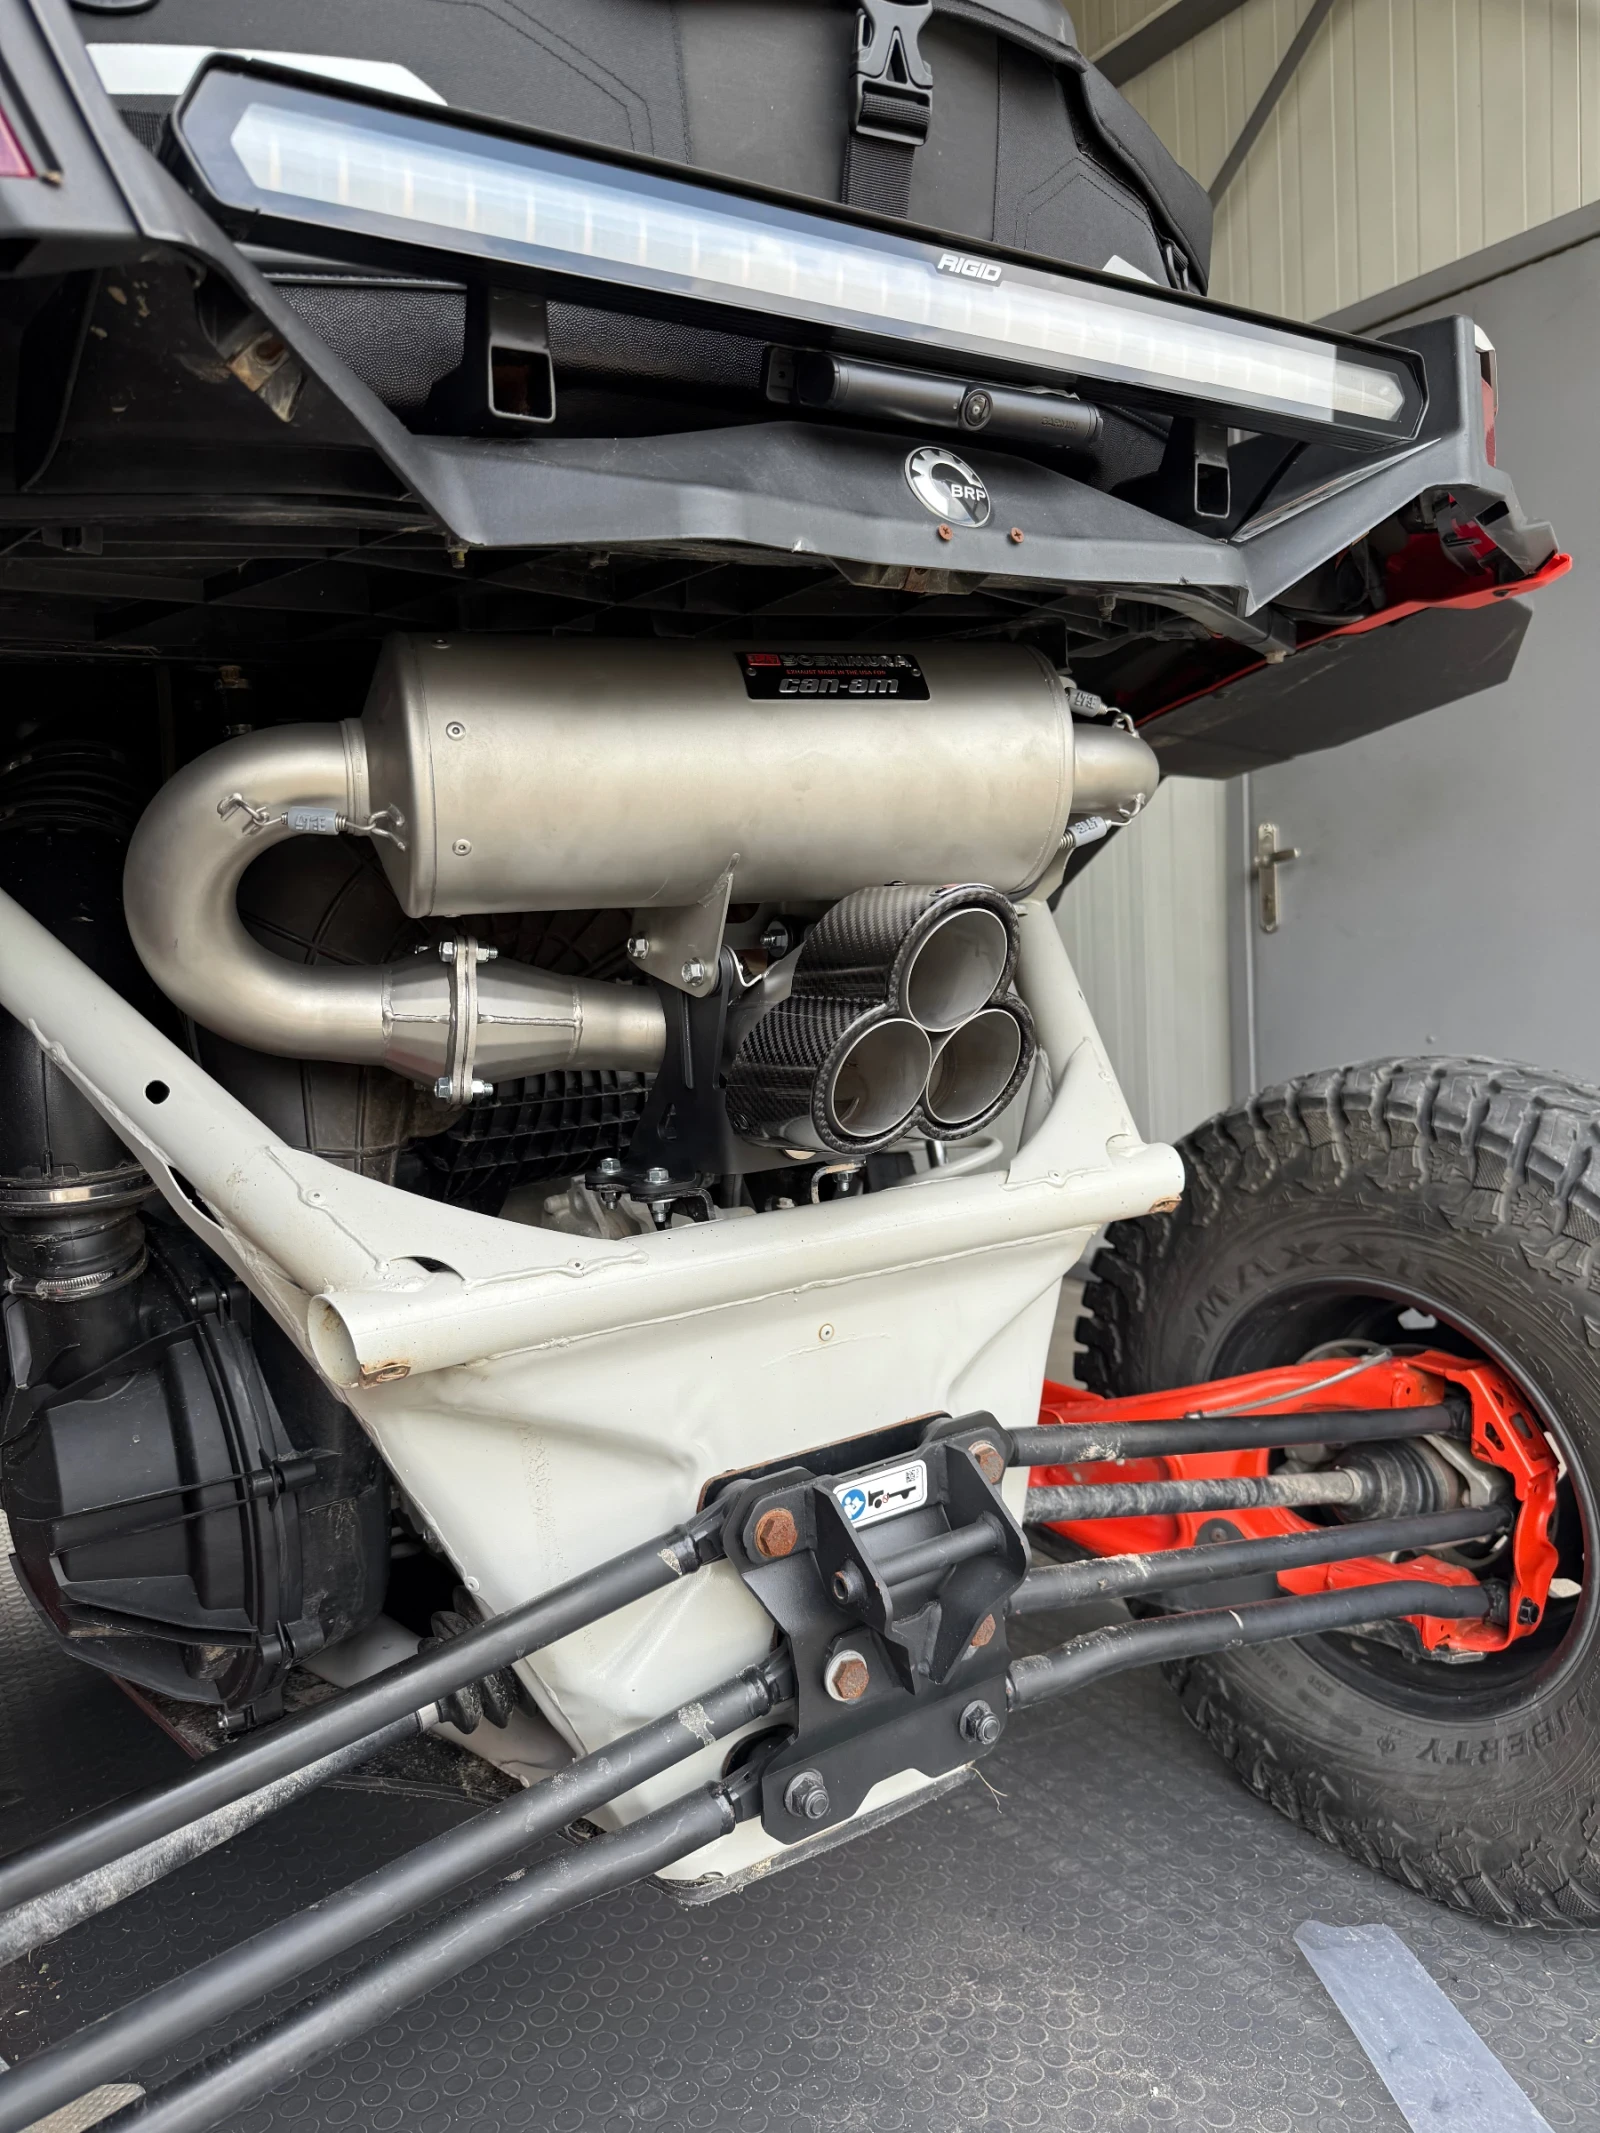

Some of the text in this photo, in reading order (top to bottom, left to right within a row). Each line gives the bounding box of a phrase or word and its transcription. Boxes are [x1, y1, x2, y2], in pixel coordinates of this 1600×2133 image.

[938, 253, 1002, 282] RIGID
[1041, 416, 1078, 430] GARMIN
[951, 484, 986, 501] BRP
[780, 654, 912, 667] YOSHIMURA
[779, 678, 899, 693] can-am
[1194, 1241, 1475, 1336] MAXXIS
[1416, 1686, 1591, 1766] LIBERTY
